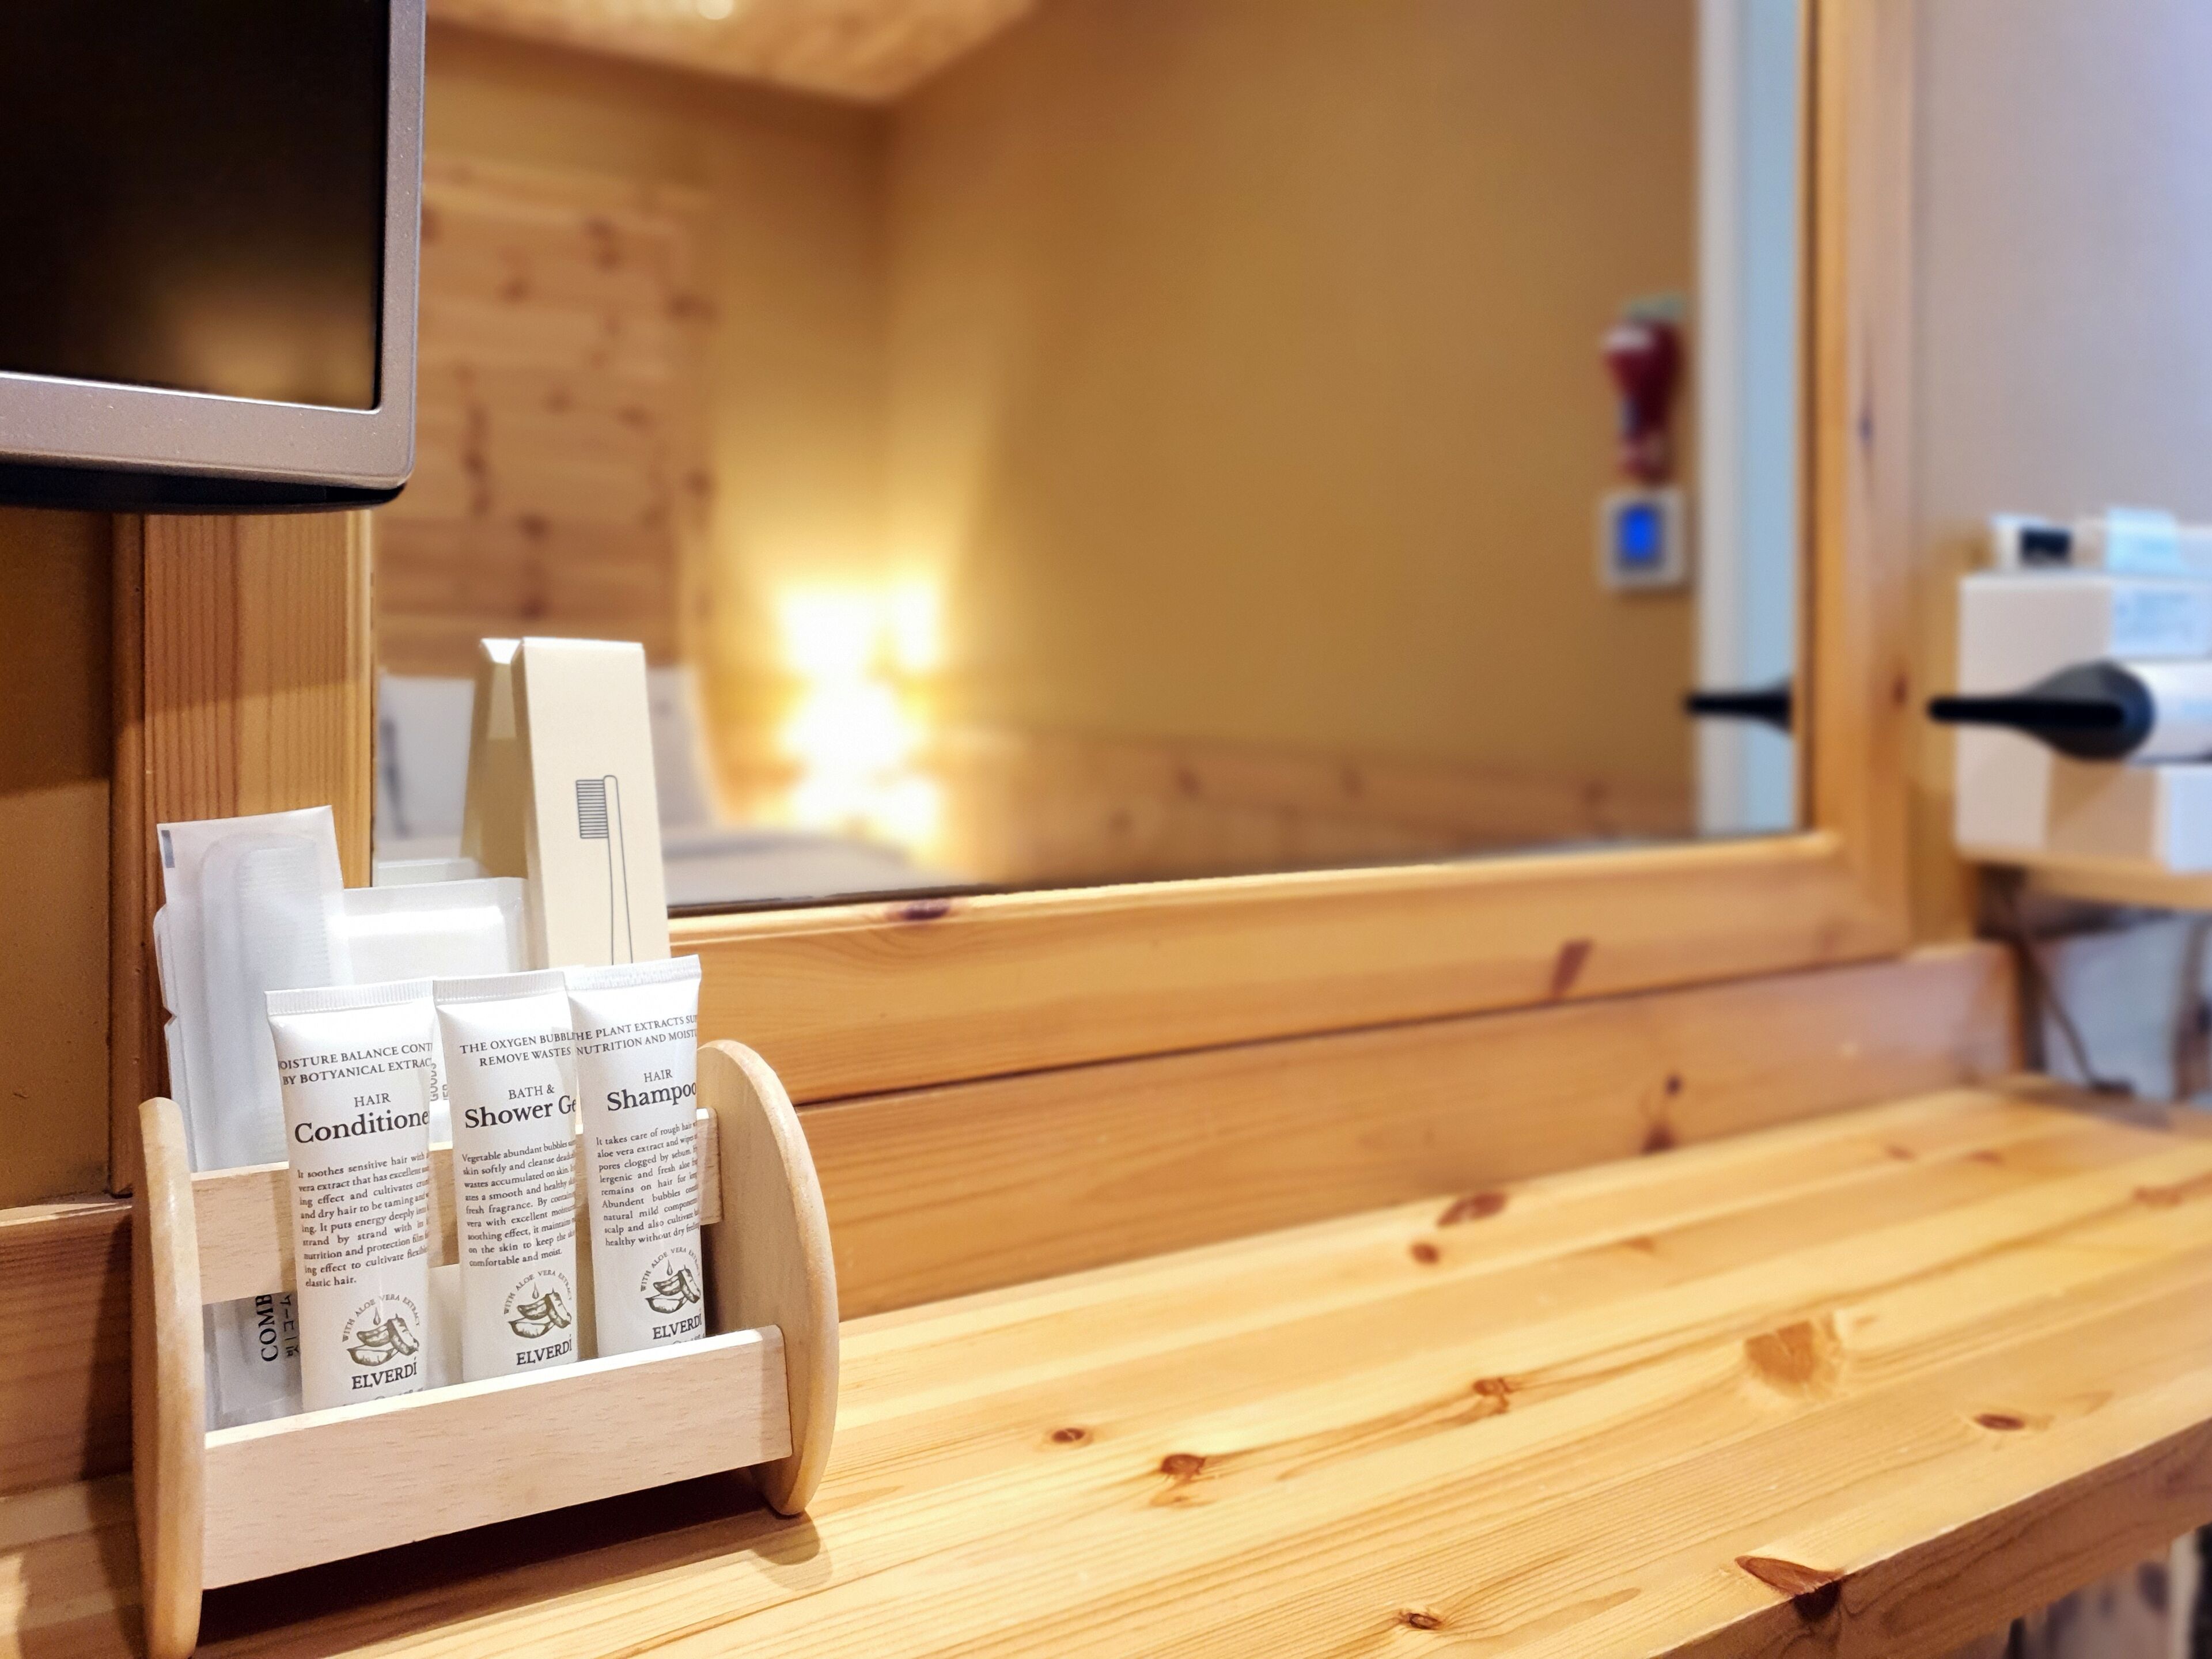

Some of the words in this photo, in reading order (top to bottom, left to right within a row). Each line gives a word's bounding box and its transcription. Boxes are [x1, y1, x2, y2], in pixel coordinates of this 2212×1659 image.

[573, 1031, 593, 1041] HE
[596, 1024, 631, 1039] PLANT
[635, 1017, 684, 1035] EXTRACTS
[460, 1042, 487, 1054] THE
[490, 1036, 537, 1051] OXYGEN
[576, 1039, 643, 1056] NUTRITION
[645, 1034, 667, 1044] AND
[278, 1053, 338, 1070] OISTURE
[341, 1047, 399, 1062] BALANCE
[402, 1043, 433, 1054] CONT
[479, 1051, 530, 1067] REMOVE
[532, 1046, 571, 1059] WASTES
[282, 1075, 297, 1085] BY
[300, 1063, 385, 1084] BOTYANICAL
[389, 1057, 432, 1071] EXTRAC
[643, 1069, 673, 1083] HAIR
[354, 1093, 391, 1108] HAIR
[509, 1085, 543, 1100] BATH
[546, 1084, 555, 1094] &
[294, 1109, 430, 1143] Conditione
[464, 1103, 553, 1129] Shower
[596, 1137, 603, 1146] It
[605, 1135, 627, 1144] takes
[630, 1133, 648, 1142] care
[650, 1128, 659, 1137] of
[660, 1125, 680, 1137] rough
[462, 1152, 501, 1164] Vegetable
[503, 1147, 542, 1158] abundant
[544, 1139, 567, 1152] bubbles
[597, 1149, 613, 1158] aloe
[616, 1147, 634, 1156] vera
[637, 1143, 664, 1154] extract
[666, 1138, 679, 1147] and
[297, 1169, 304, 1179] It
[308, 1166, 344, 1178] soothes
[349, 1160, 388, 1172] sensitive
[391, 1157, 407, 1166] hair
[411, 1152, 425, 1162] with
[463, 1166, 479, 1175] skin
[482, 1163, 506, 1175] softly
[509, 1160, 525, 1171] and
[528, 1157, 555, 1168] cleanse
[599, 1162, 620, 1173] pores
[624, 1155, 657, 1168] clogged
[660, 1153, 669, 1164] by
[600, 1173, 632, 1185] lergenic
[637, 1169, 653, 1179] and
[658, 1165, 676, 1176] fresh
[679, 1162, 690, 1171] aloe
[317, 1180, 350, 1190] extract
[353, 1177, 372, 1186] that
[373, 1173, 388, 1182] has
[491, 1172, 544, 1187] accumulated
[546, 1170, 555, 1178] on
[601, 1185, 634, 1196] remains
[641, 1183, 652, 1191] on
[658, 1178, 673, 1188] hair
[677, 1175, 686, 1184] for
[300, 1198, 313, 1207] ing
[317, 1193, 345, 1205] effect
[350, 1190, 368, 1200] and
[373, 1184, 413, 1196] cultivates
[488, 1189, 523, 1200] smooth
[527, 1185, 541, 1195] and
[544, 1179, 567, 1192] healthy
[602, 1196, 644, 1209] Abundent
[652, 1188, 681, 1202] bubbles
[301, 1210, 316, 1219] and
[318, 1209, 334, 1219] dry
[338, 1207, 358, 1217] hair
[359, 1205, 369, 1213] to
[372, 1201, 382, 1210] be
[384, 1197, 414, 1209] taming
[466, 1206, 484, 1214] fresh
[488, 1201, 533, 1214] fragrance.
[537, 1198, 547, 1208] By
[604, 1210, 633, 1221] natural
[639, 1207, 659, 1218] mild
[302, 1225, 317, 1235] ing.
[320, 1223, 327, 1232] It
[331, 1221, 352, 1233] puts
[355, 1215, 387, 1228] energy
[389, 1209, 414, 1221] deeply
[486, 1217, 506, 1226] with
[511, 1212, 548, 1224] excellent
[604, 1223, 624, 1235] scalp
[628, 1221, 644, 1233] and
[648, 1218, 664, 1229] also
[302, 1236, 329, 1246] strand
[338, 1234, 349, 1244] by
[357, 1228, 387, 1241] strand
[394, 1222, 412, 1234] with
[468, 1231, 502, 1241] soothing
[505, 1228, 531, 1238] effect,
[533, 1226, 539, 1234] it
[605, 1237, 636, 1248] healthy
[638, 1230, 671, 1244] without
[673, 1227, 684, 1237] dry
[304, 1249, 342, 1260] nutrition
[346, 1245, 363, 1257] and
[366, 1238, 410, 1256] protection
[481, 1244, 495, 1253] the
[499, 1241, 518, 1252] skin
[523, 1240, 532, 1249] to
[536, 1236, 554, 1249] keep
[305, 1266, 317, 1276] ing
[320, 1262, 346, 1273] effect
[365, 1253, 404, 1267] cultivate
[469, 1253, 520, 1267] comfortable
[522, 1251, 538, 1262] and
[306, 1277, 332, 1287] elastic
[334, 1276, 356, 1285] hair.
[641, 1270, 652, 1292] WITH
[651, 1251, 668, 1268] ALOE
[503, 1291, 516, 1315] WITH
[516, 1274, 535, 1291] ALOE
[255, 1294, 279, 1362] COMB
[342, 1318, 355, 1342] WITH
[355, 1298, 376, 1317] ALOE
[351, 1356, 418, 1390] ELVERDÍ
